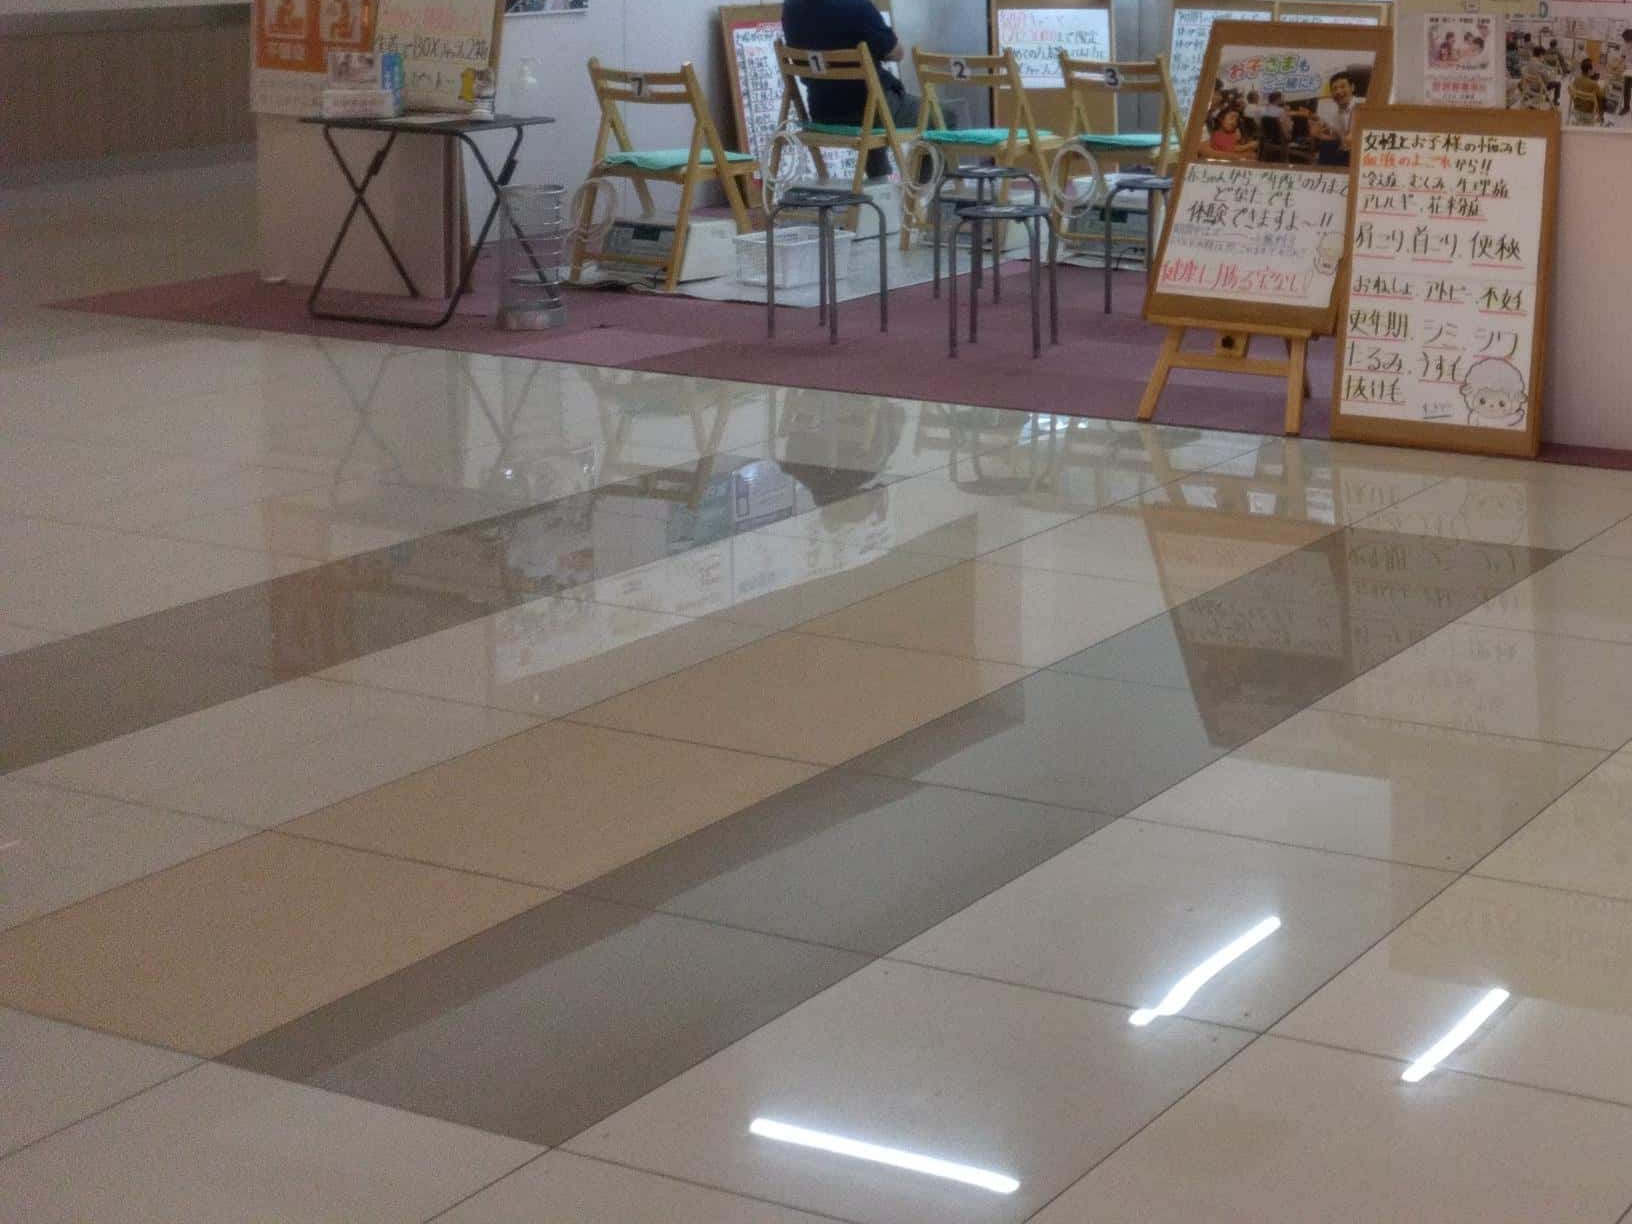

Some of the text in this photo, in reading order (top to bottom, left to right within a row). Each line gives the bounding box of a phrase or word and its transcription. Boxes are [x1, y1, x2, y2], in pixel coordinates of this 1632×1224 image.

[952, 61, 967, 79] 2
[1104, 67, 1119, 86] 3
[631, 77, 644, 97] 7
